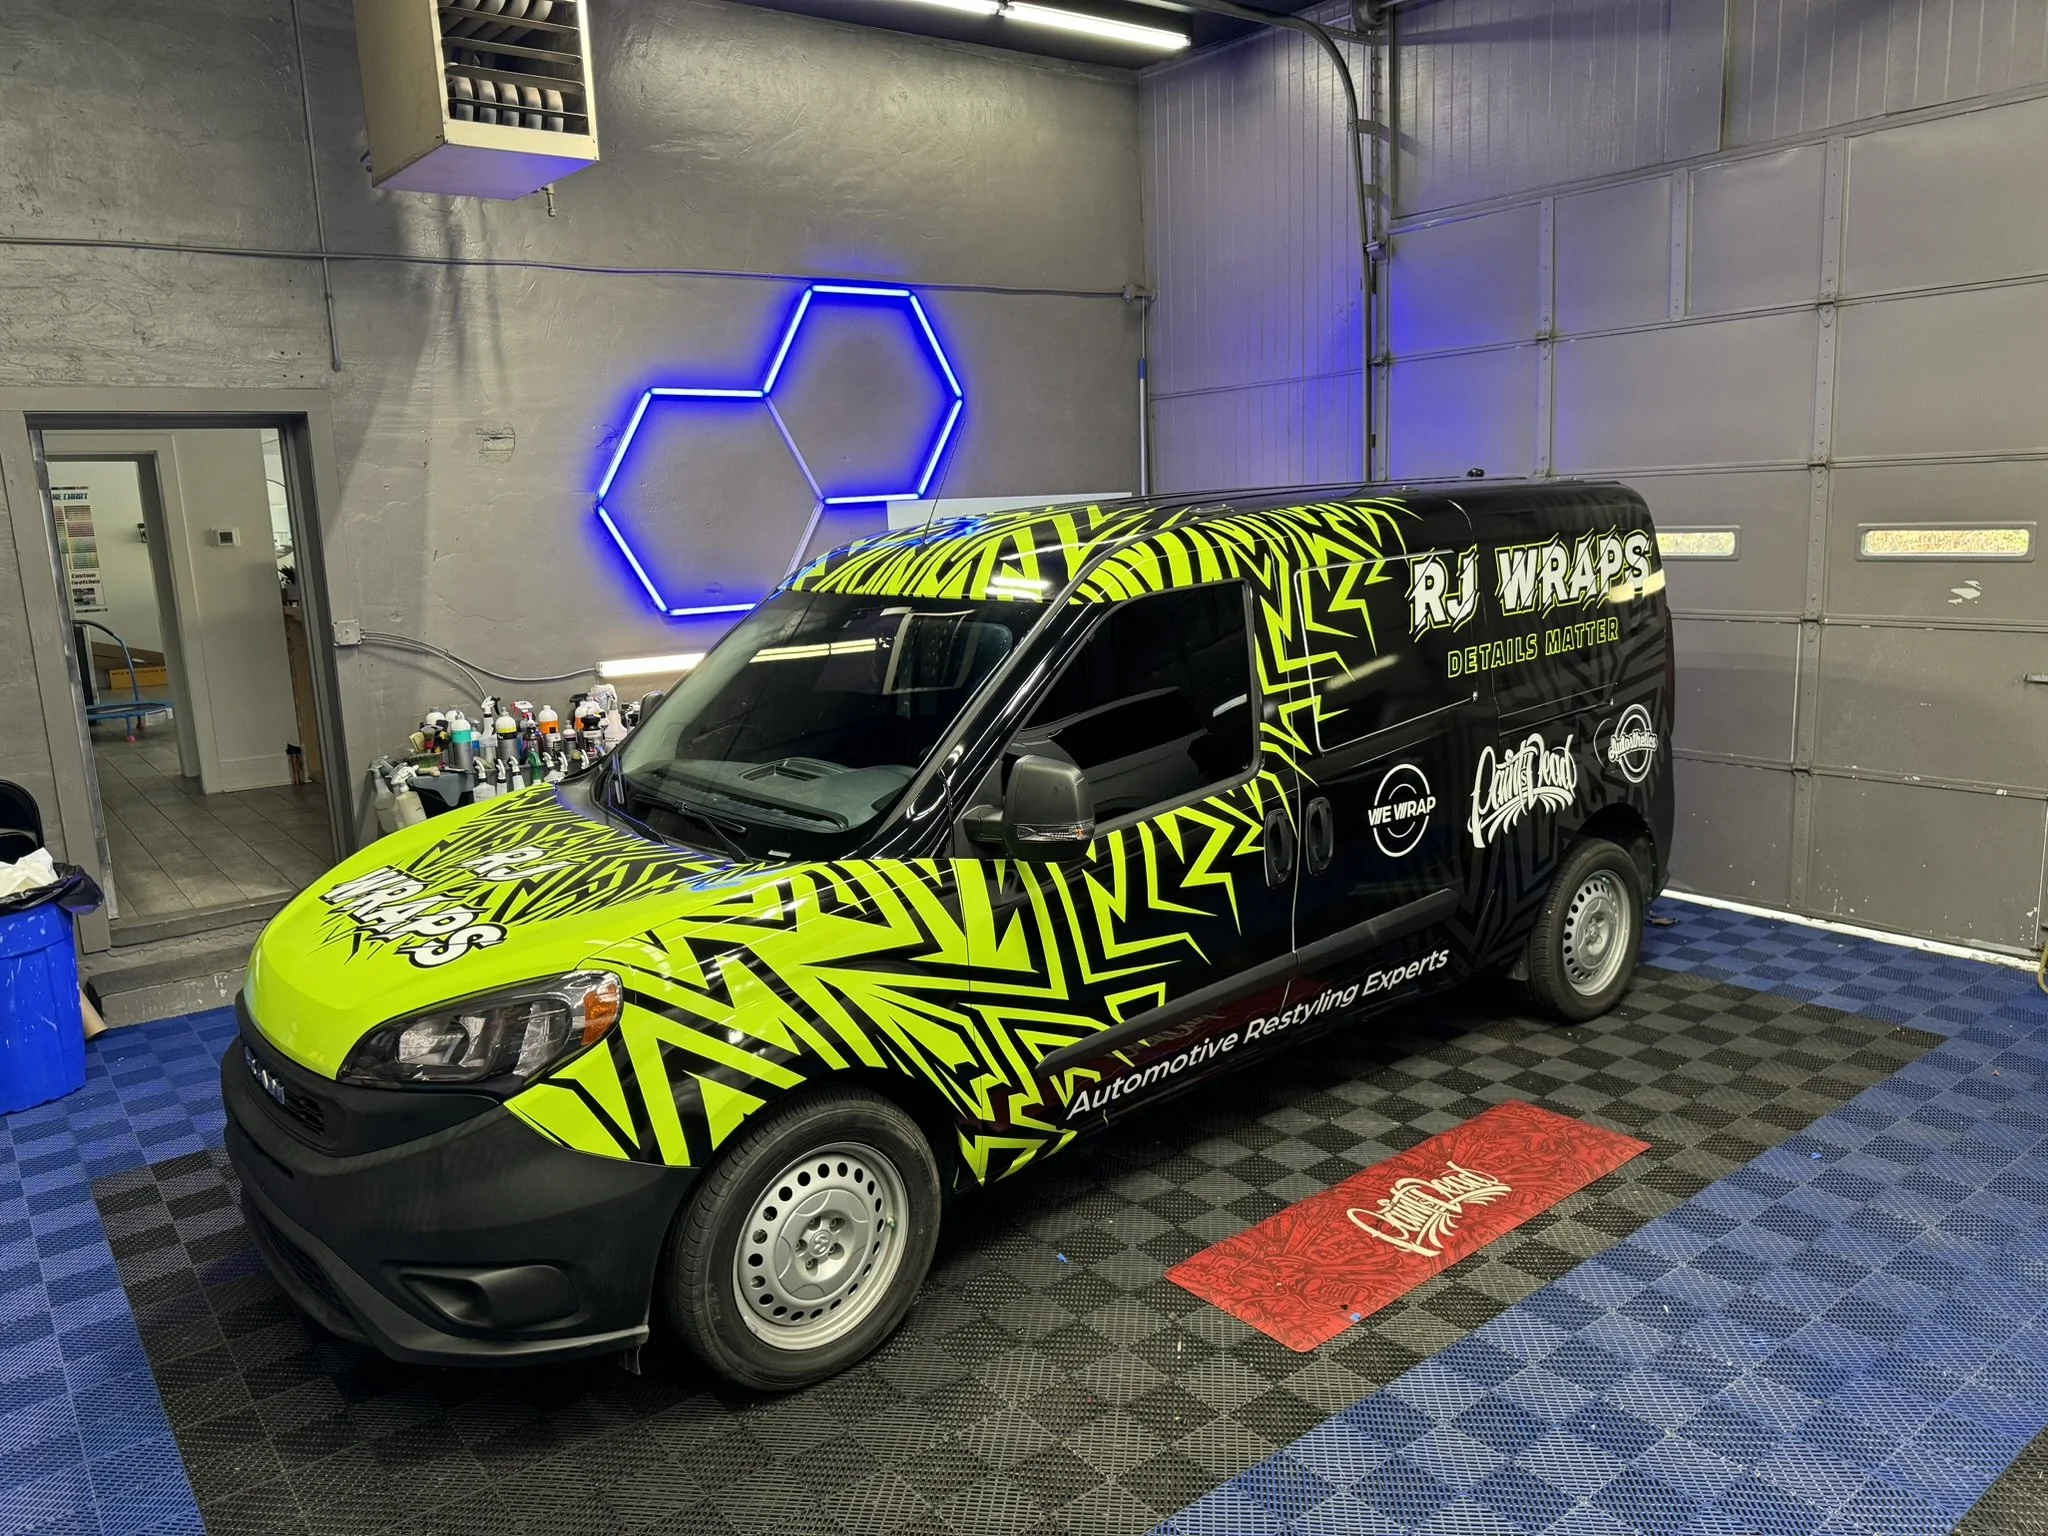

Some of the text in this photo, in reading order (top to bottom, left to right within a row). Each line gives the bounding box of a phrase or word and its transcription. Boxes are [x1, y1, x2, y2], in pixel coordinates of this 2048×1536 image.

[1407, 528, 1653, 638] RJ WRAPS
[1448, 617, 1619, 678] DETAILS MATTER
[1368, 796, 1436, 826] WE WRAP
[453, 845, 581, 882] RJ
[318, 865, 508, 968] WRAPS
[1066, 946, 1450, 1121] Automotive Restyling Experts
